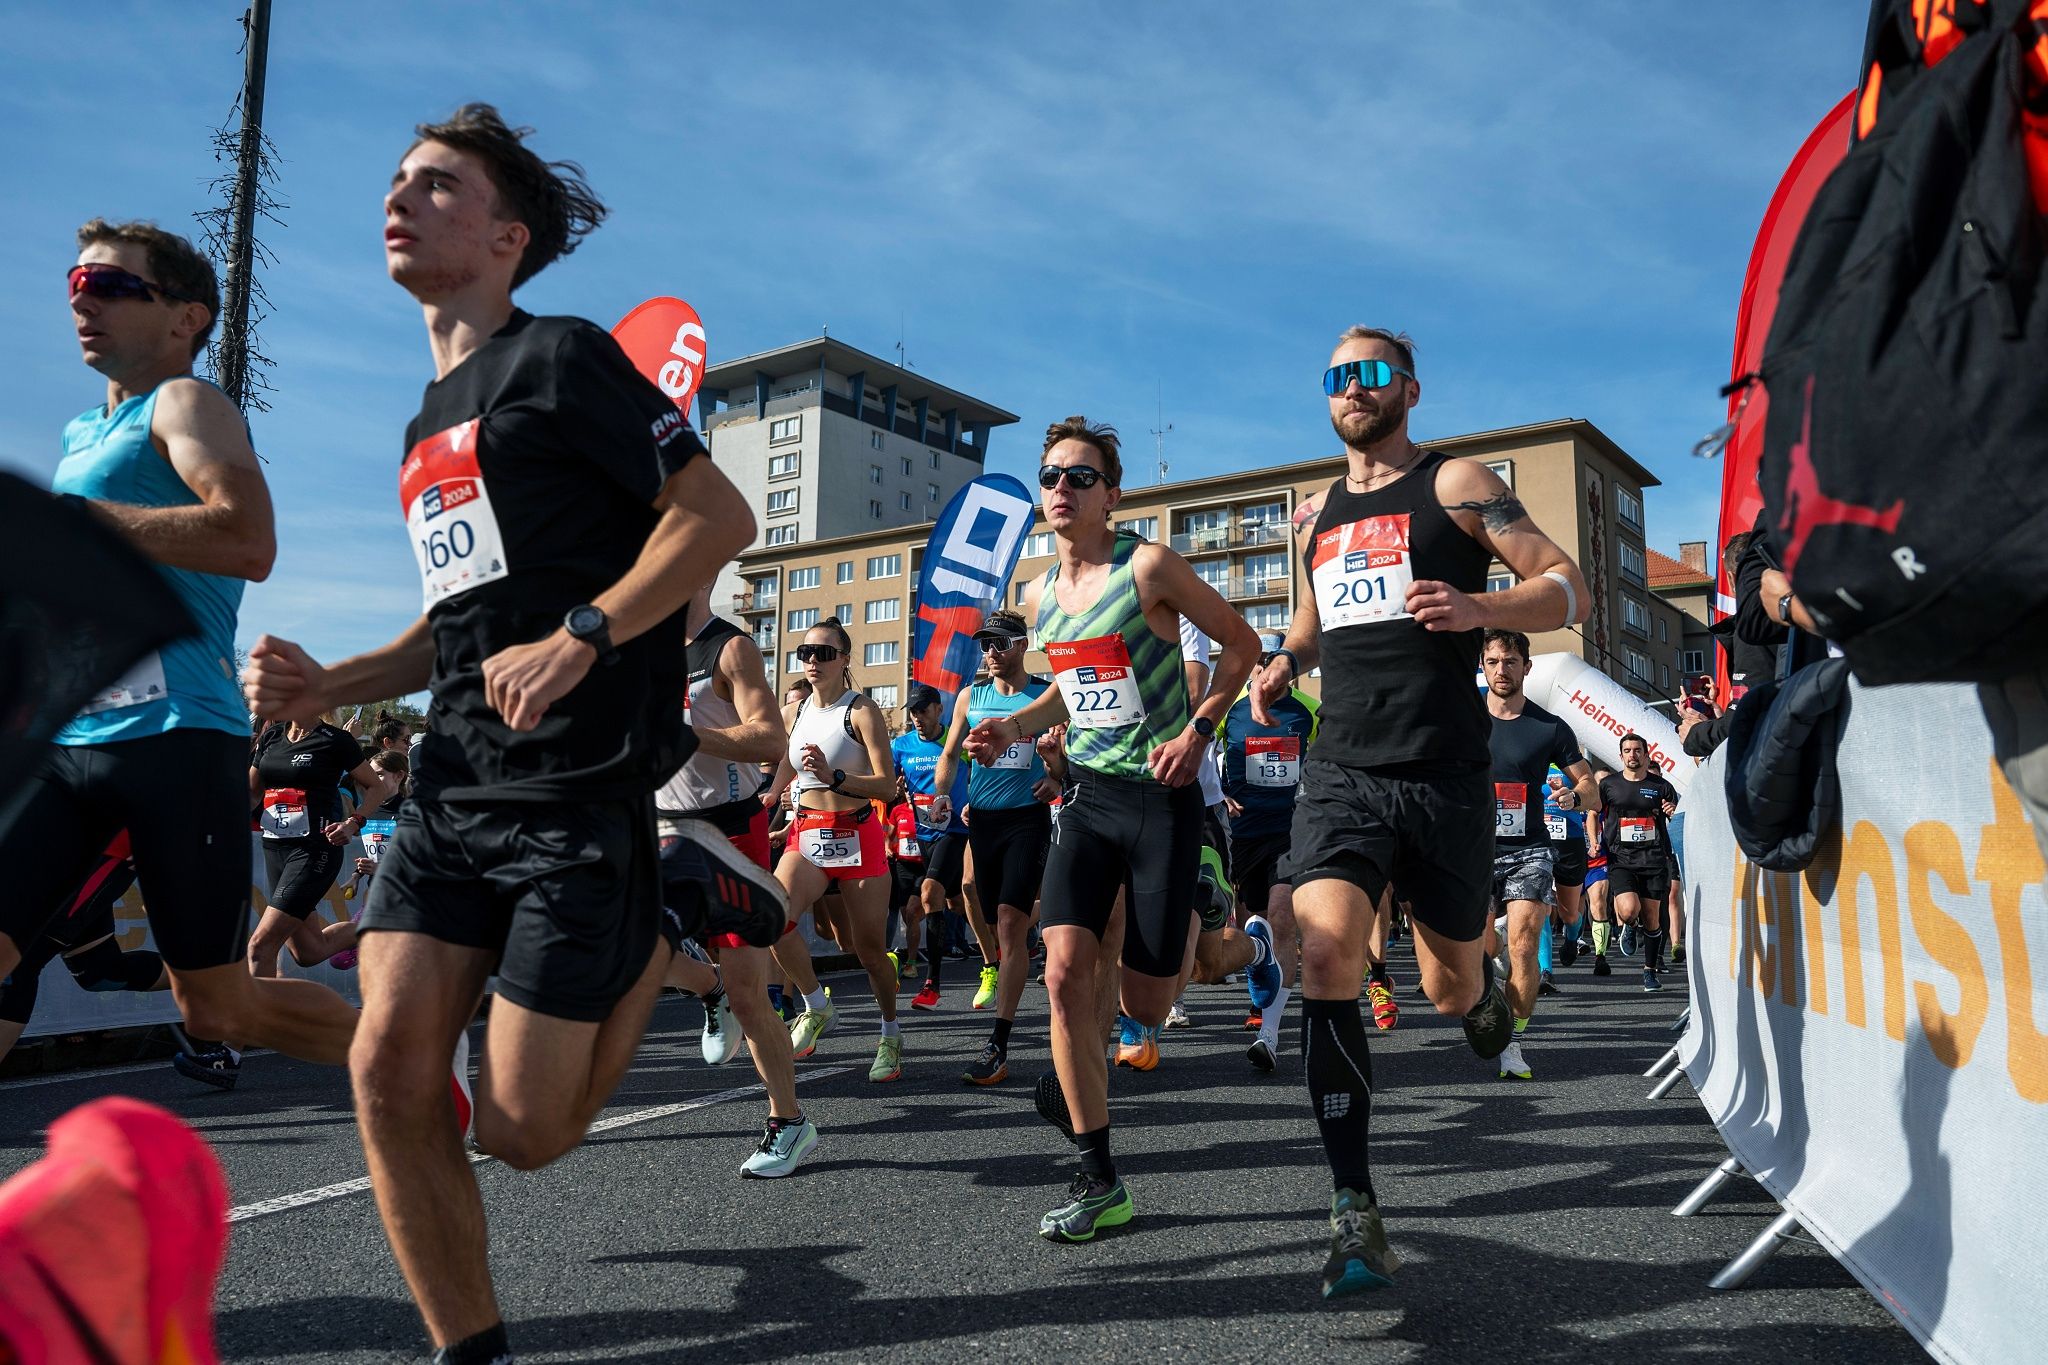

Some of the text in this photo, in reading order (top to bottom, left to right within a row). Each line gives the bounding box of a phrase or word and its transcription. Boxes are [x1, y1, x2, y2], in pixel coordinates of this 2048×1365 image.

[1370, 554, 1397, 566] 2024
[1332, 575, 1387, 608] 201
[1049, 647, 1077, 657] DESÍTKA
[1099, 670, 1122, 681] 2024
[1071, 688, 1122, 712] 222
[1569, 689, 1676, 774] Heimsden
[1258, 765, 1288, 778] 133
[274, 816, 289, 830] 15
[1631, 832, 1647, 842] 65
[365, 844, 390, 855] 100
[811, 842, 849, 857] 255
